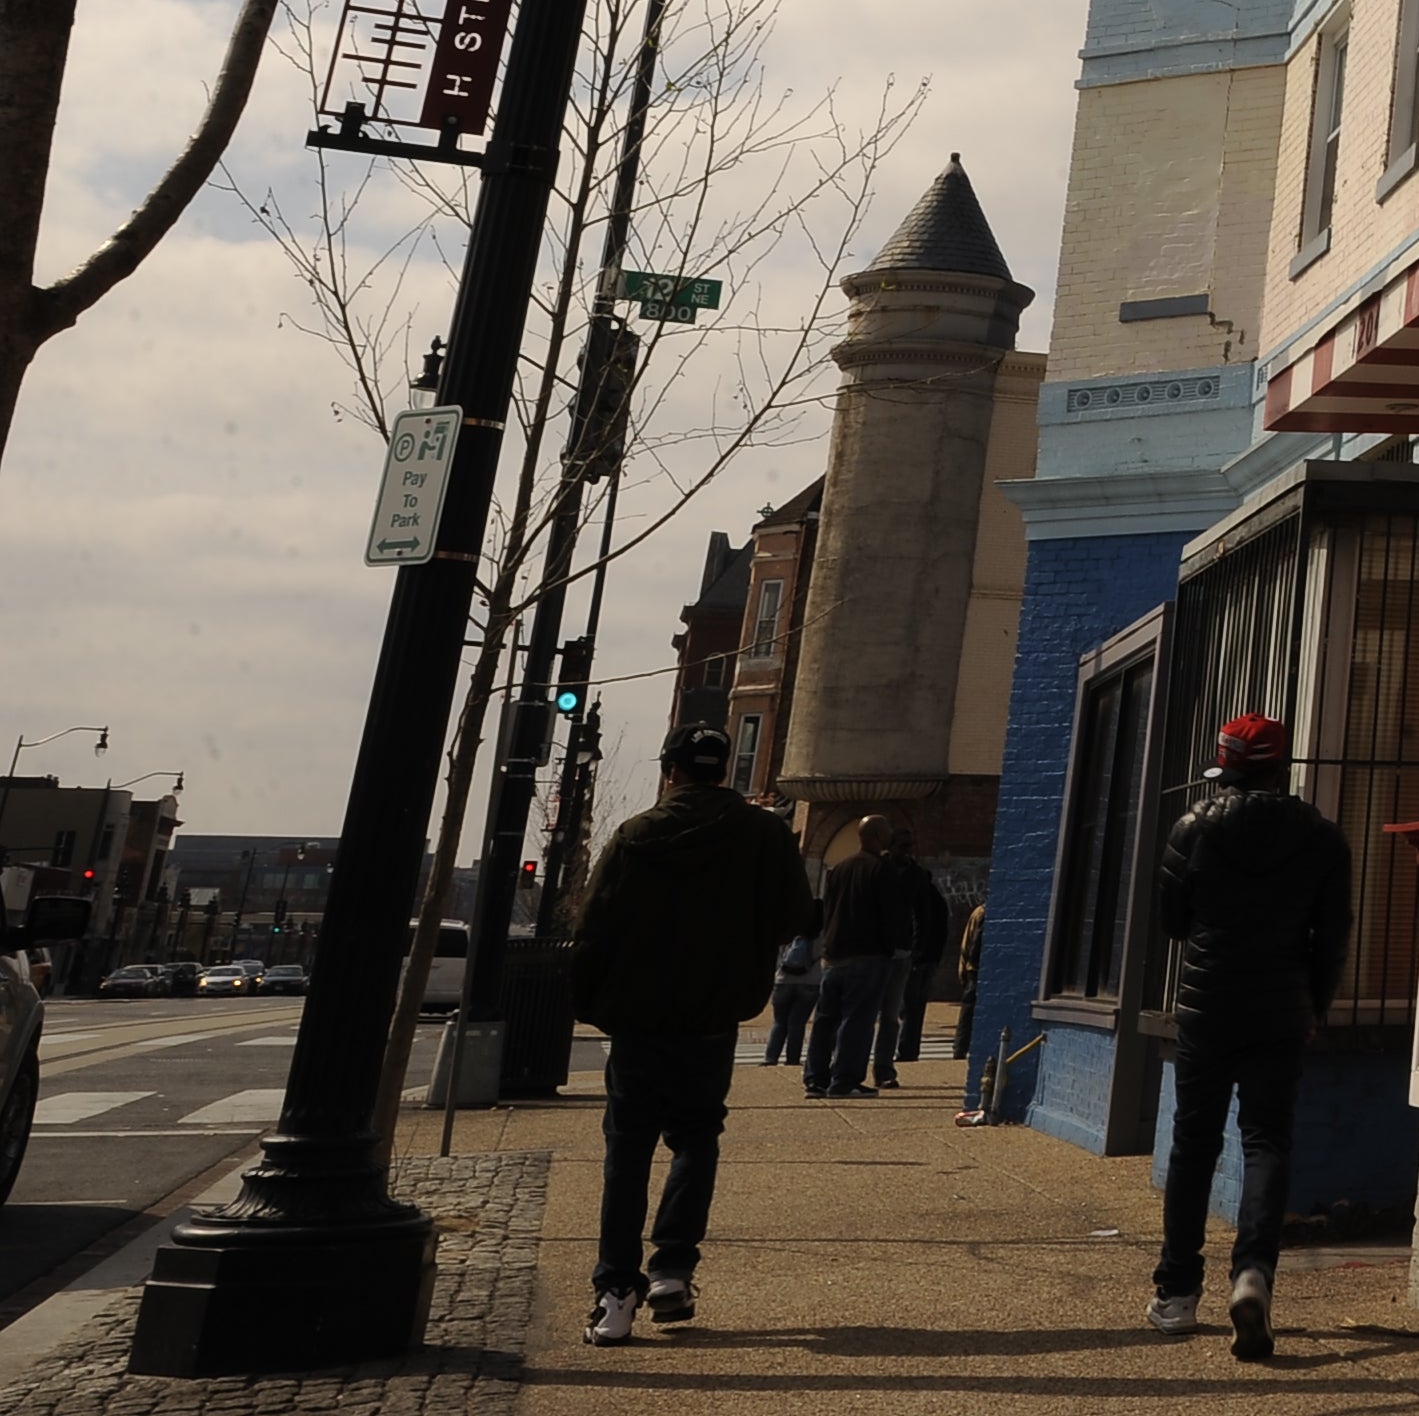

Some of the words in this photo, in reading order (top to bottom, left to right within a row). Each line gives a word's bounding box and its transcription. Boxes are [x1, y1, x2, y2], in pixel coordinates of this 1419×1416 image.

[442, 72, 472, 98] H
[693, 282, 711, 294] ST
[690, 294, 710, 305] NE
[646, 303, 692, 322] 800
[402, 471, 428, 489] Pay
[403, 494, 418, 509] To
[390, 513, 421, 528] Park
